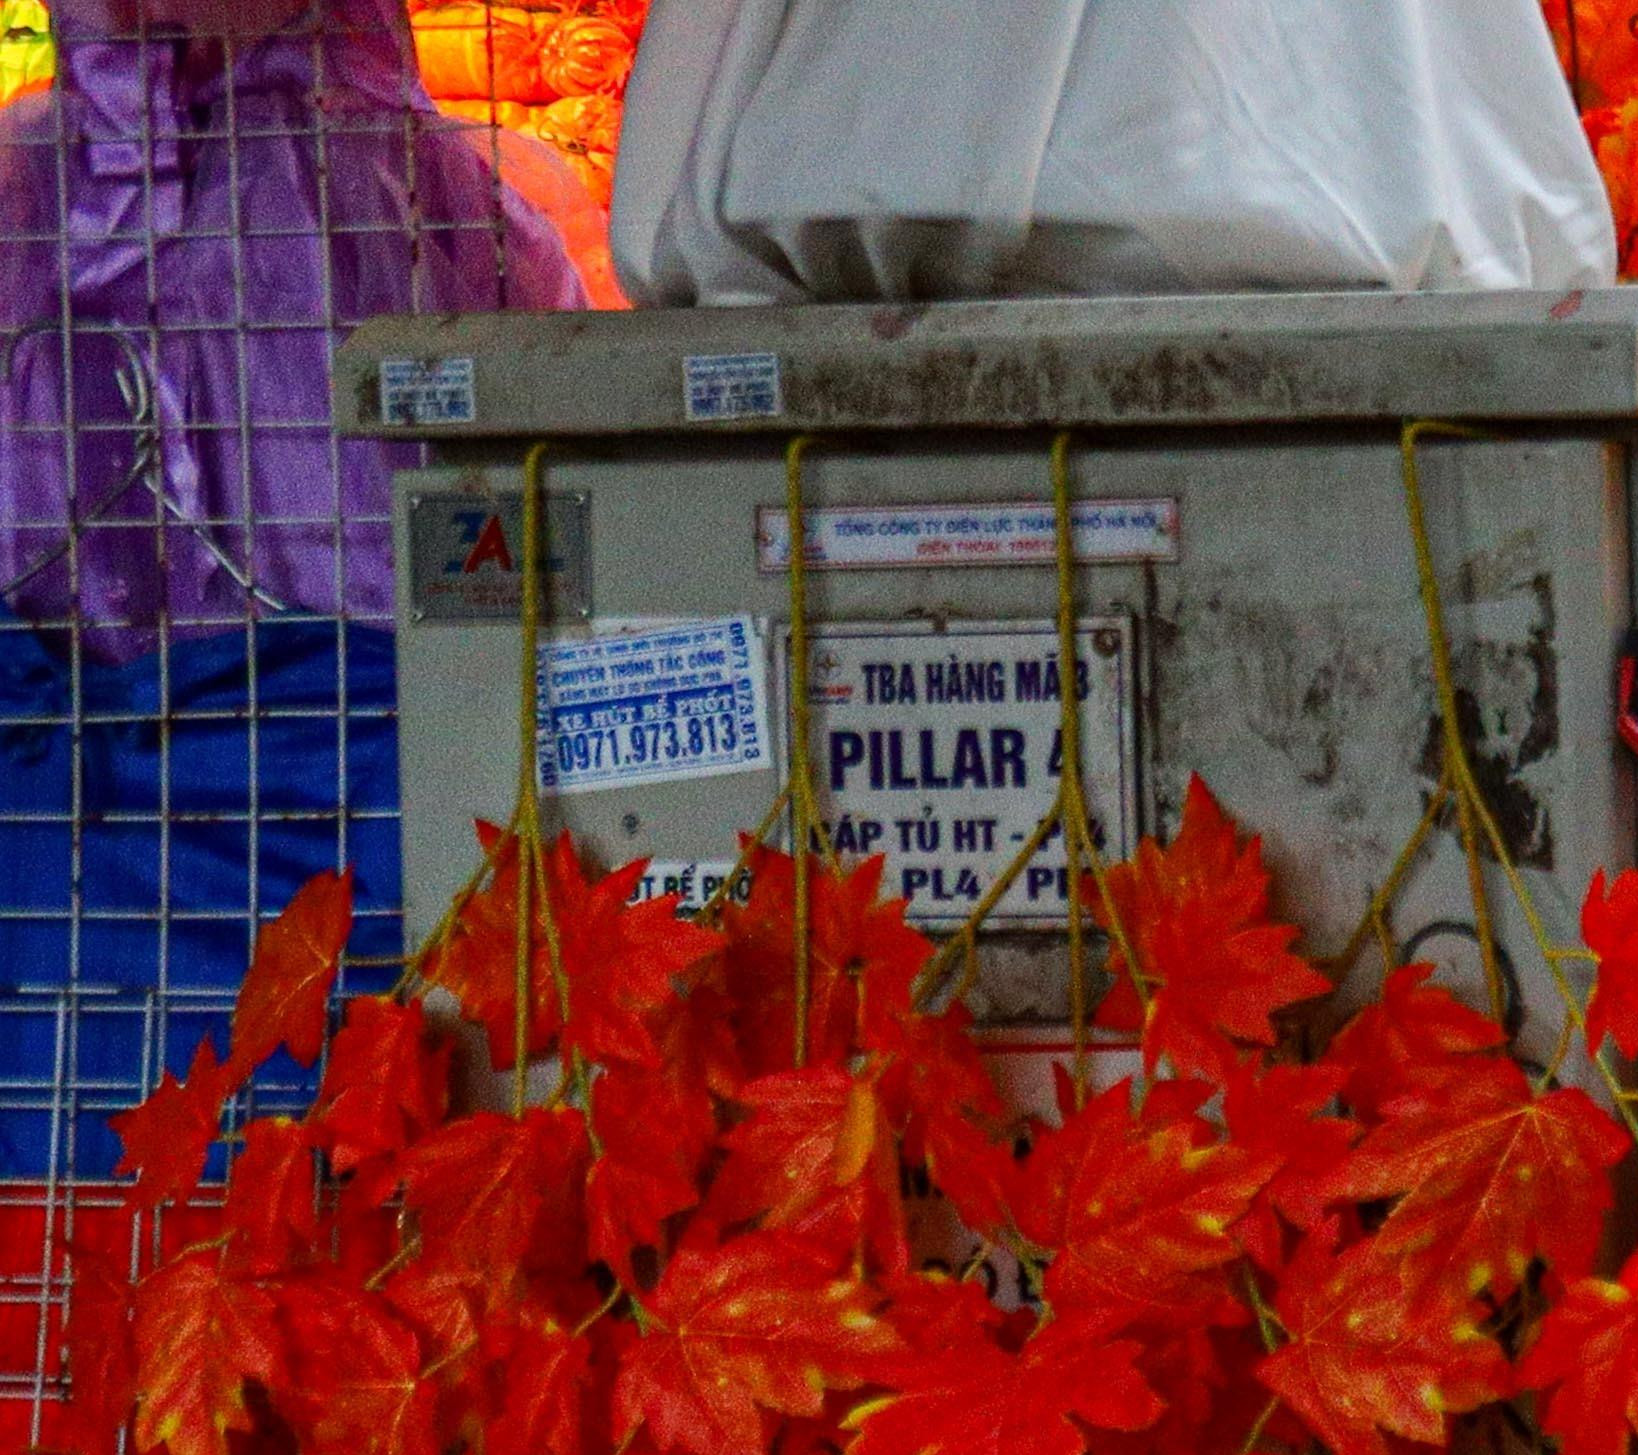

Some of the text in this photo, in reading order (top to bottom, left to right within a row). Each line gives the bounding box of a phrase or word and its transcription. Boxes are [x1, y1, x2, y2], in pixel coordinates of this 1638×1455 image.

[861, 662, 916, 704] TBA
[925, 653, 1005, 704] HÀNG
[589, 704, 636, 729] HÚT
[558, 712, 737, 774] 0971.973.813
[829, 728, 1027, 791] PILLAR
[895, 805, 941, 853] TỦ
[953, 819, 998, 853] HT
[900, 867, 981, 903] PL4
